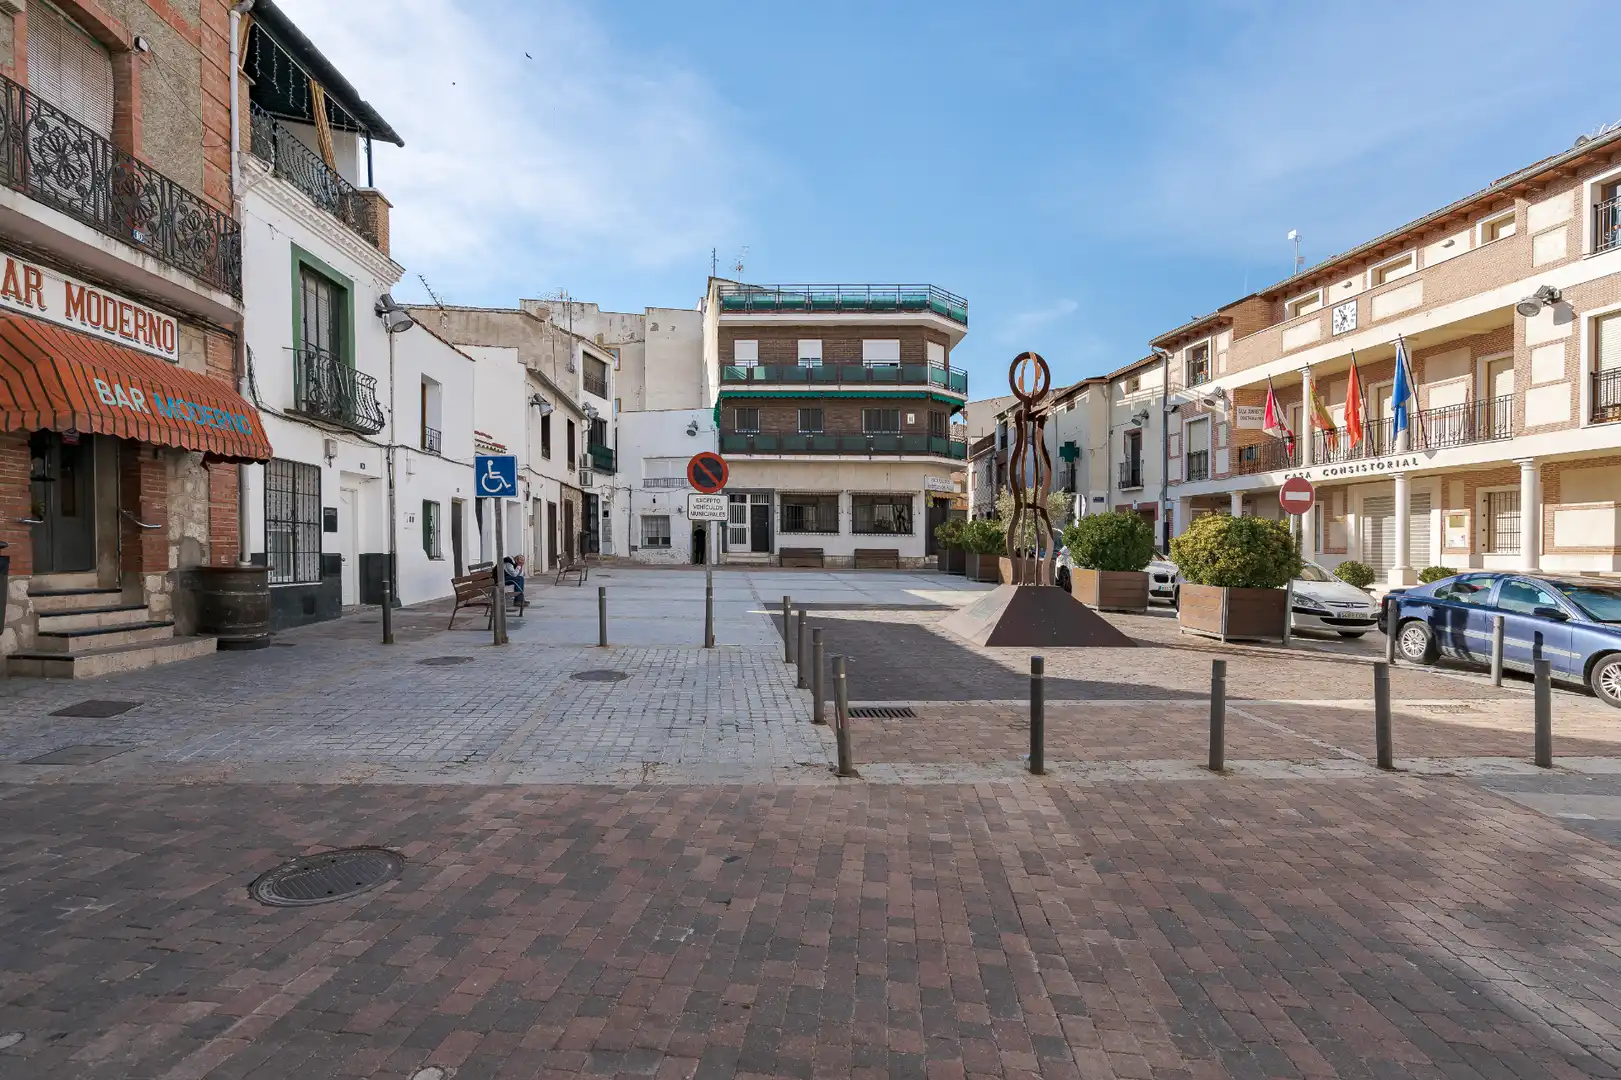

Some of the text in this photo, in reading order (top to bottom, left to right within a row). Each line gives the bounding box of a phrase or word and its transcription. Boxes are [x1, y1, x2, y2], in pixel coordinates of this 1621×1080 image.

[64, 280, 176, 354] MODERNO
[94, 378, 252, 435] BAR MODERNO
[1284, 457, 1419, 480] CASA CONSISTORIAL
